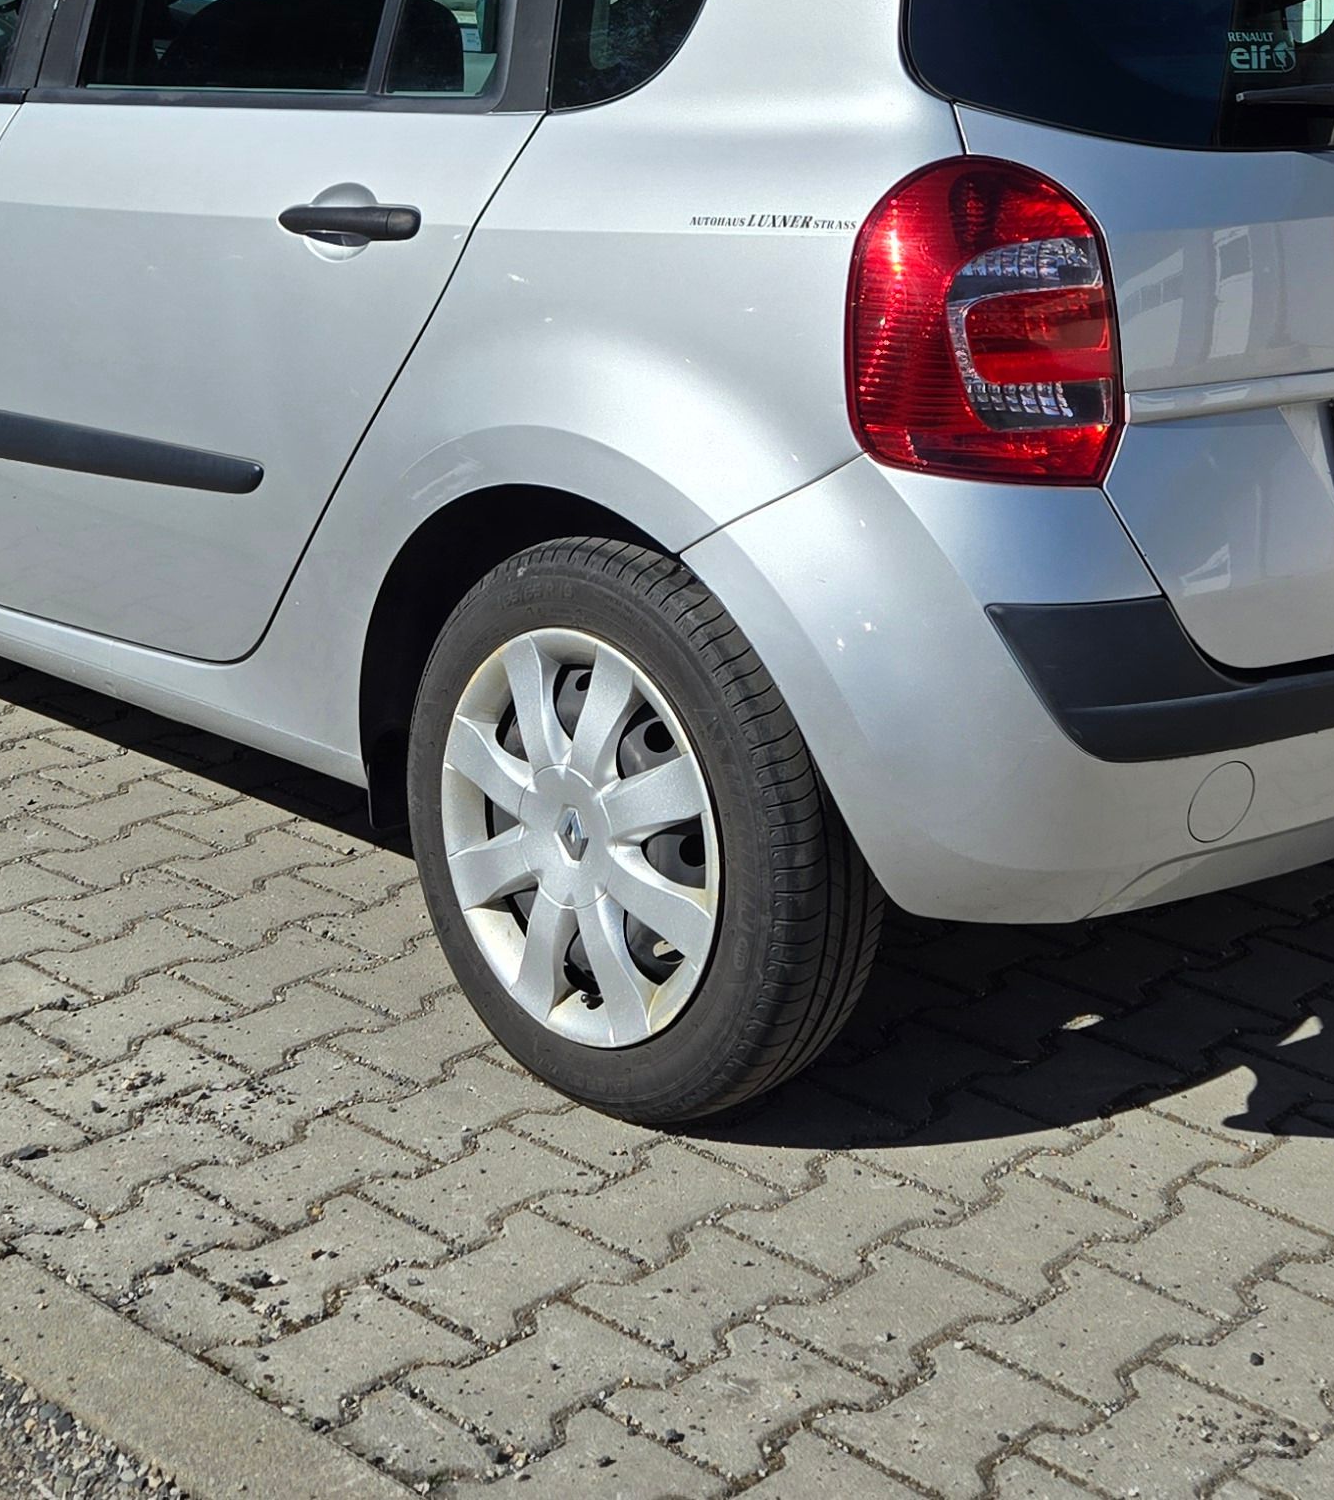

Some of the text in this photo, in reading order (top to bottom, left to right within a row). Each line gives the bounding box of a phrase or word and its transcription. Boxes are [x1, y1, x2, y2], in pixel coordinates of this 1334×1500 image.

[1227, 31, 1275, 42] RENAULT
[1230, 44, 1272, 70] elf
[689, 215, 746, 227] AUTOHAUS
[747, 213, 813, 229] LUXNER
